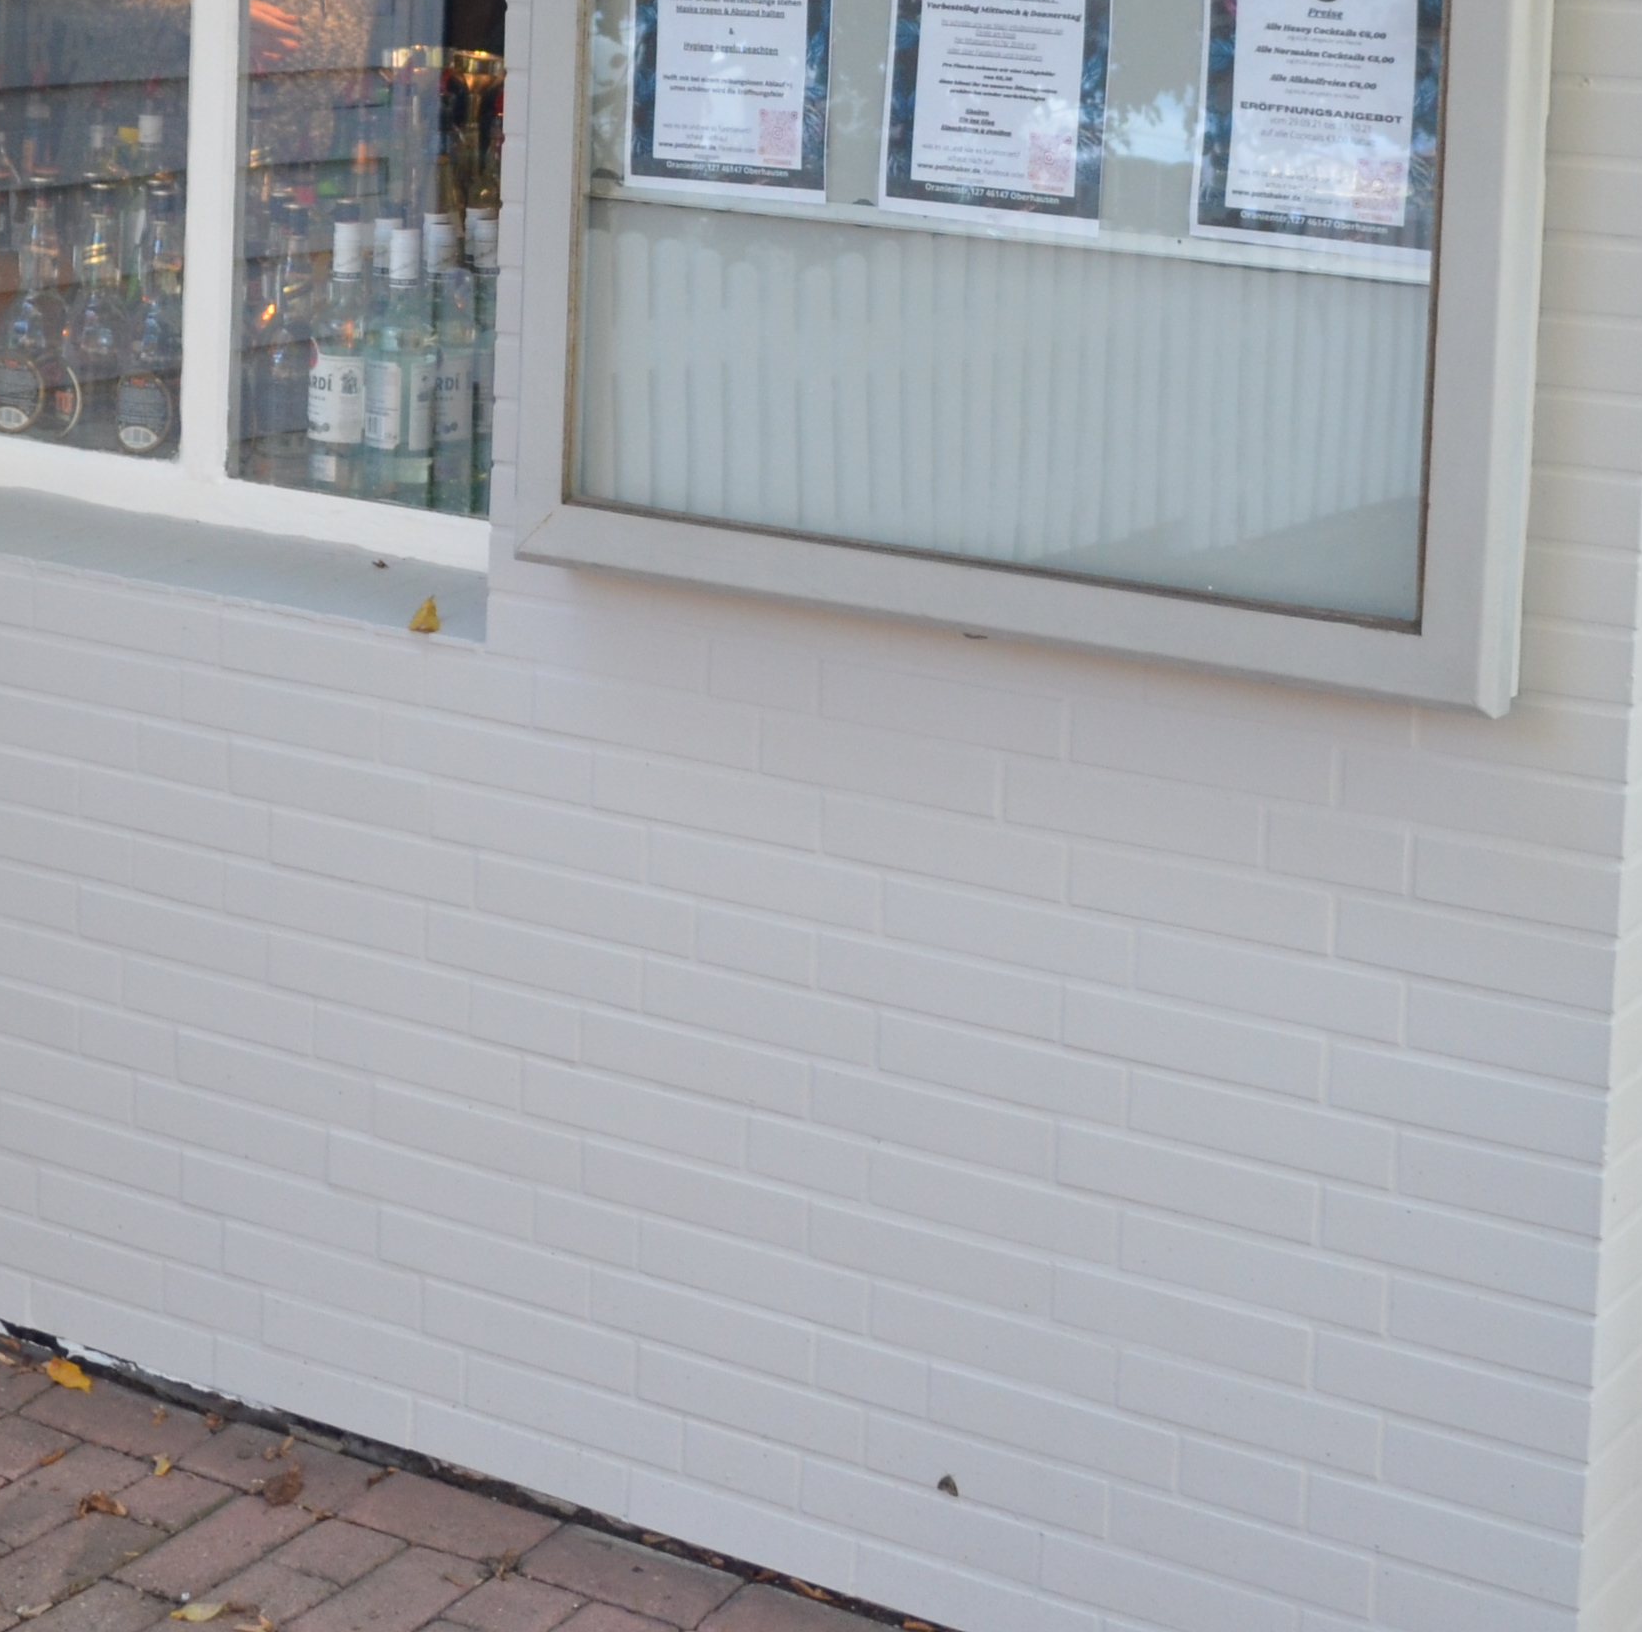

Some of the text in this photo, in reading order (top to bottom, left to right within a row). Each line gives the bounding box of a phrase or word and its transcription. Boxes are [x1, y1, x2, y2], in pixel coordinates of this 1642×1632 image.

[676, 5, 698, 14] Maske
[699, 7, 722, 15] tragen
[730, 8, 760, 17] Abstand
[761, 9, 785, 19] halten
[980, 6, 1021, 15] Mittwoch
[1030, 10, 1081, 22] Donnerstag
[1307, 7, 1343, 20] Preise
[1265, 22, 1282, 31] Alle
[1283, 24, 1312, 35] Heavy
[1313, 26, 1357, 37] Cocktails
[683, 42, 714, 52] Hygiene
[1255, 45, 1272, 53] Alle
[1273, 47, 1320, 57] Normalen
[1321, 50, 1365, 61] Cocktails
[1270, 73, 1287, 82] Alle
[1240, 101, 1403, 124] ERÖFFNUNGSANGEBOT
[721, 164, 742, 173] 46147
[743, 166, 788, 177] Oberhausen
[985, 188, 1009, 198] 46147
[1010, 191, 1059, 204] Oberhausen
[1307, 217, 1332, 228] 46147
[1333, 219, 1387, 234] Oberhausen
